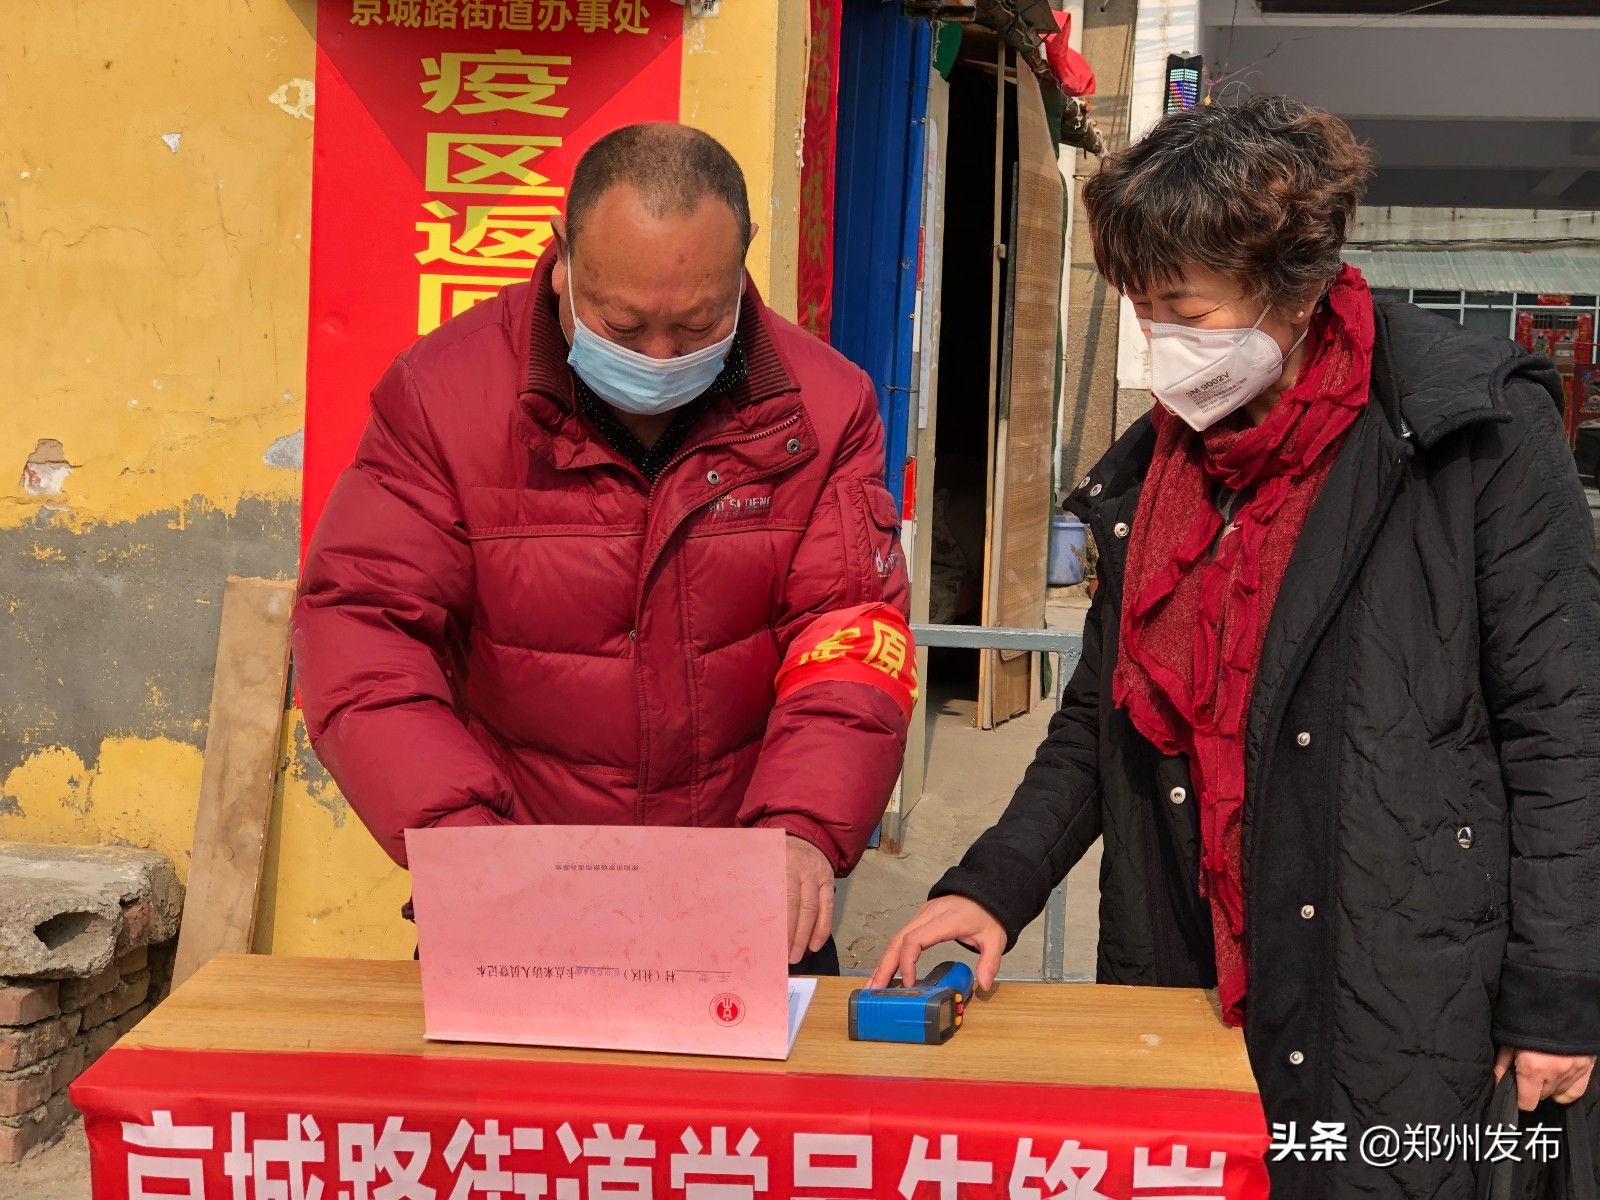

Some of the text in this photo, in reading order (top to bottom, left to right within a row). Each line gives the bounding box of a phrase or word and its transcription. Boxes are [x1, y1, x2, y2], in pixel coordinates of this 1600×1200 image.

[350, 0, 651, 34] 京城路街道办事处
[1202, 371, 1230, 391] 9002V
[476, 964, 576, 980] 卡点来访人员登记本
